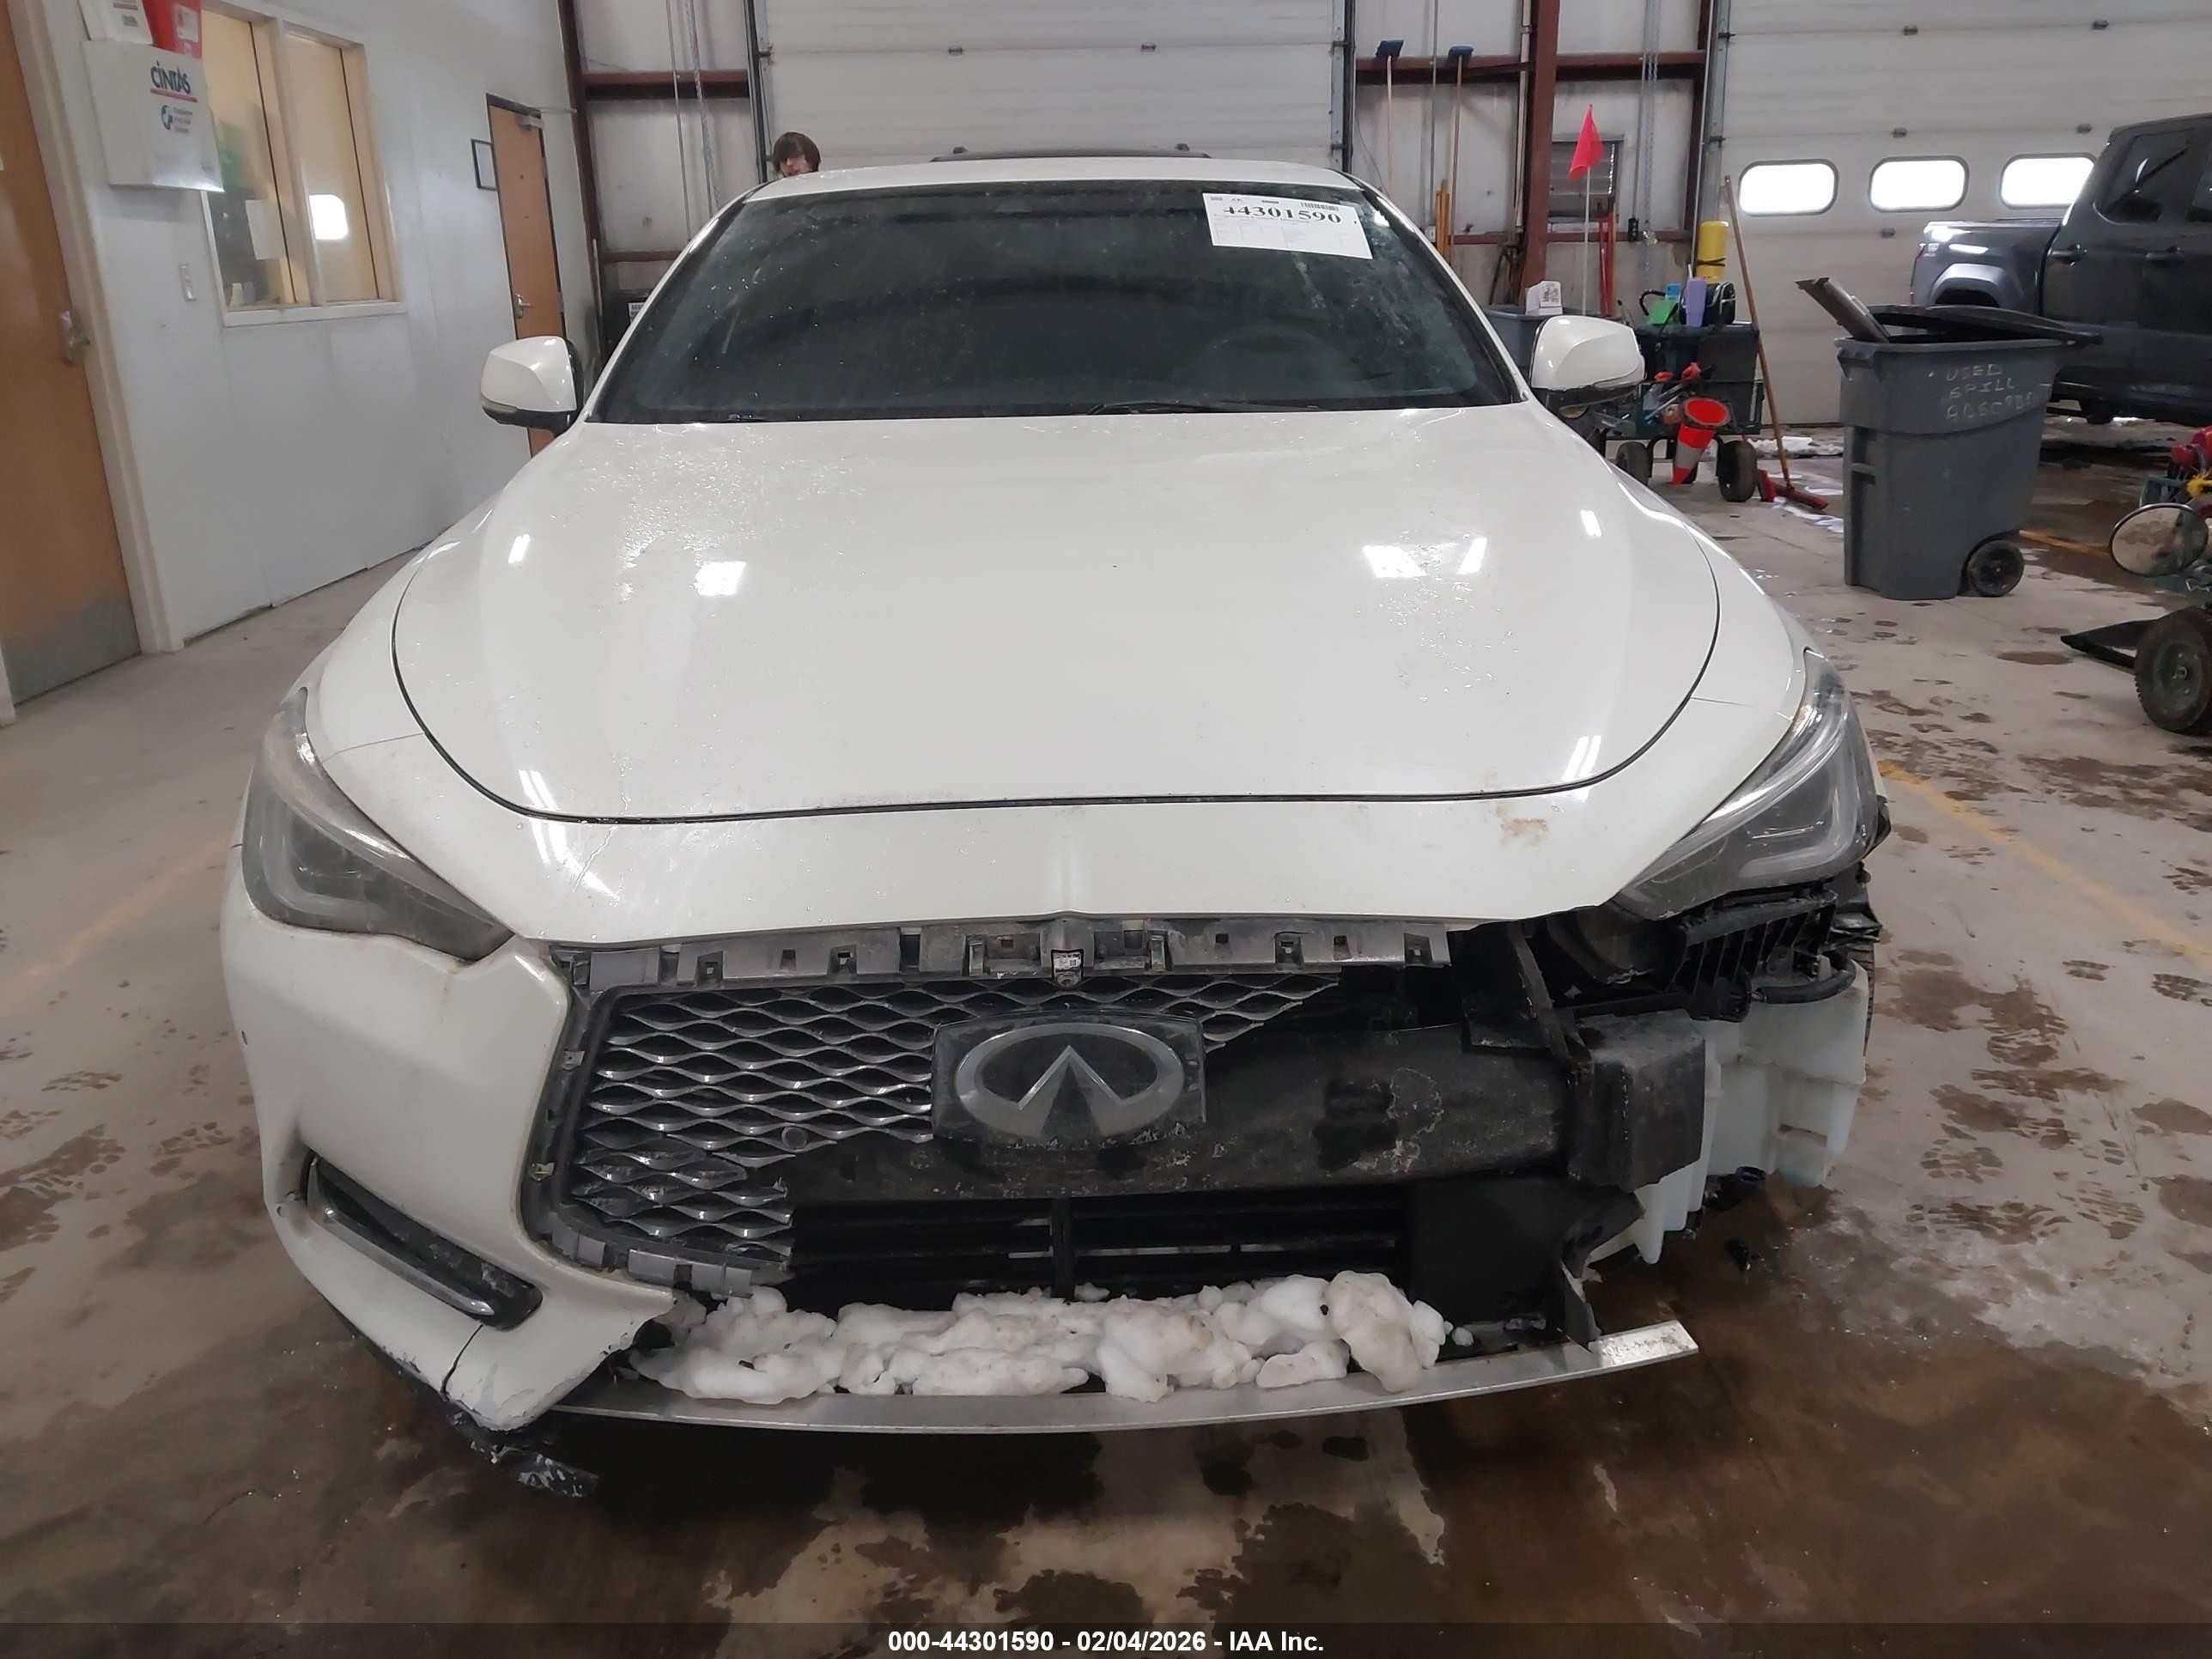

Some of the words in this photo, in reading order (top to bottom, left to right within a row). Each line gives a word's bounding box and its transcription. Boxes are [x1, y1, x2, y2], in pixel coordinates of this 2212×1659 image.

[1224, 205, 1341, 223] 44301590
[1946, 363, 2003, 381] USED
[1949, 377, 2015, 398] SPILL
